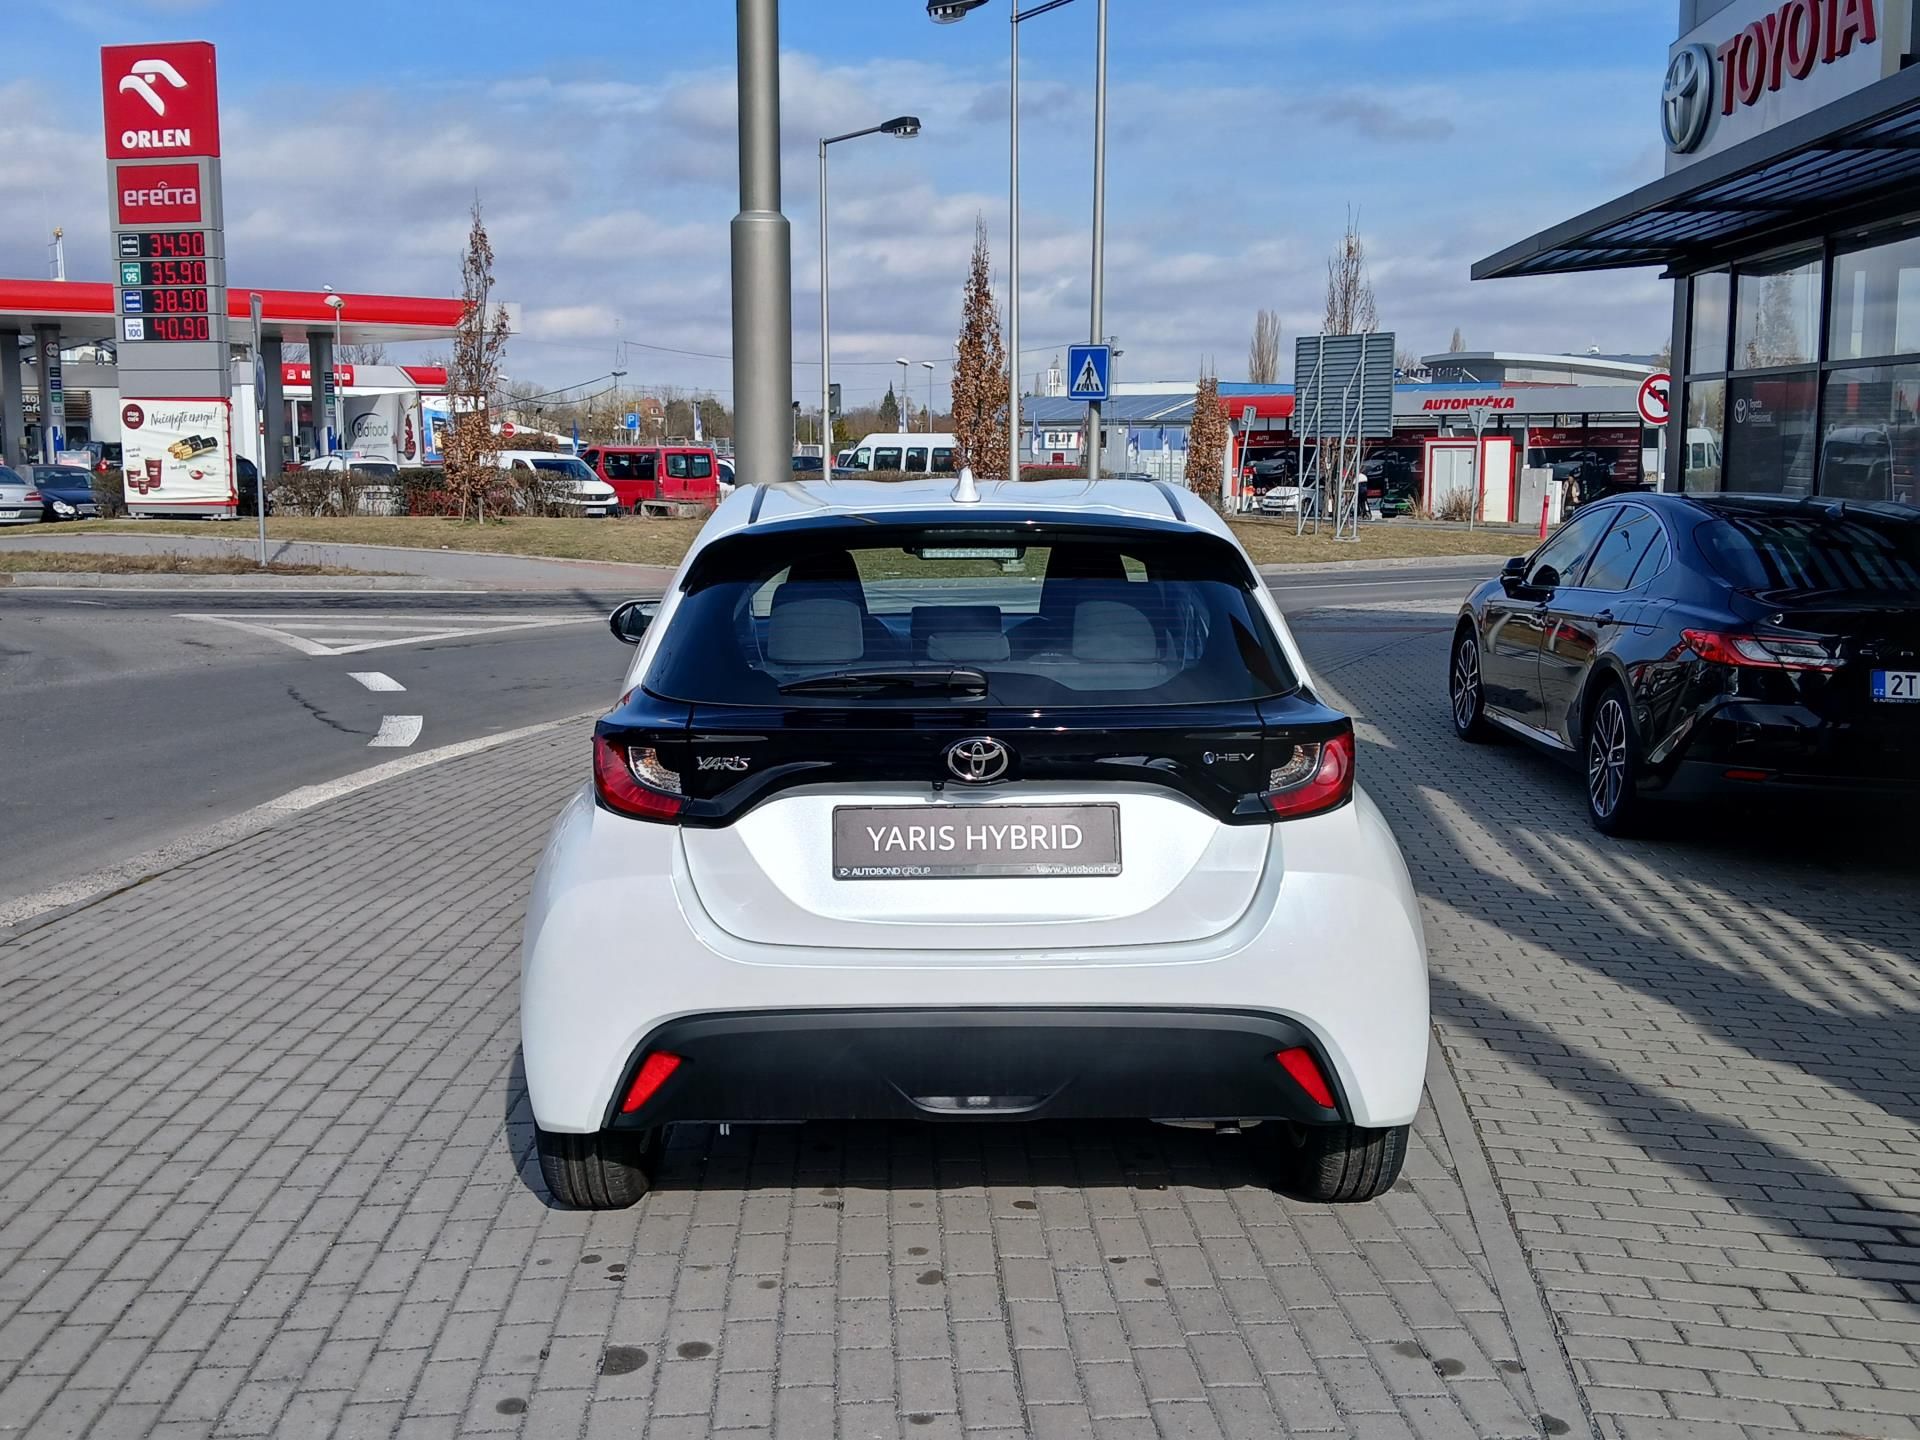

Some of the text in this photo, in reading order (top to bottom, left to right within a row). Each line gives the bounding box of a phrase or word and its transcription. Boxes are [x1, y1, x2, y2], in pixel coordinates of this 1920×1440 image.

[1716, 0, 1876, 116] TOYOTA
[121, 128, 191, 149] ORLEN
[150, 232, 205, 257] 34.90
[126, 273, 138, 282] 95
[151, 261, 206, 285] 35.90
[152, 289, 207, 312] 38.90
[127, 328, 142, 338] 100
[153, 317, 208, 340] 40.90
[1423, 395, 1515, 411] AUTOMYČKA
[628, 415, 635, 425] P
[696, 756, 751, 771] YARIS
[1215, 753, 1255, 761] HEV
[866, 824, 1083, 851] YARIS HYBRID
[851, 866, 931, 876] AUTOBOND GROUP
[1036, 865, 1118, 874] www.autobond.cz
